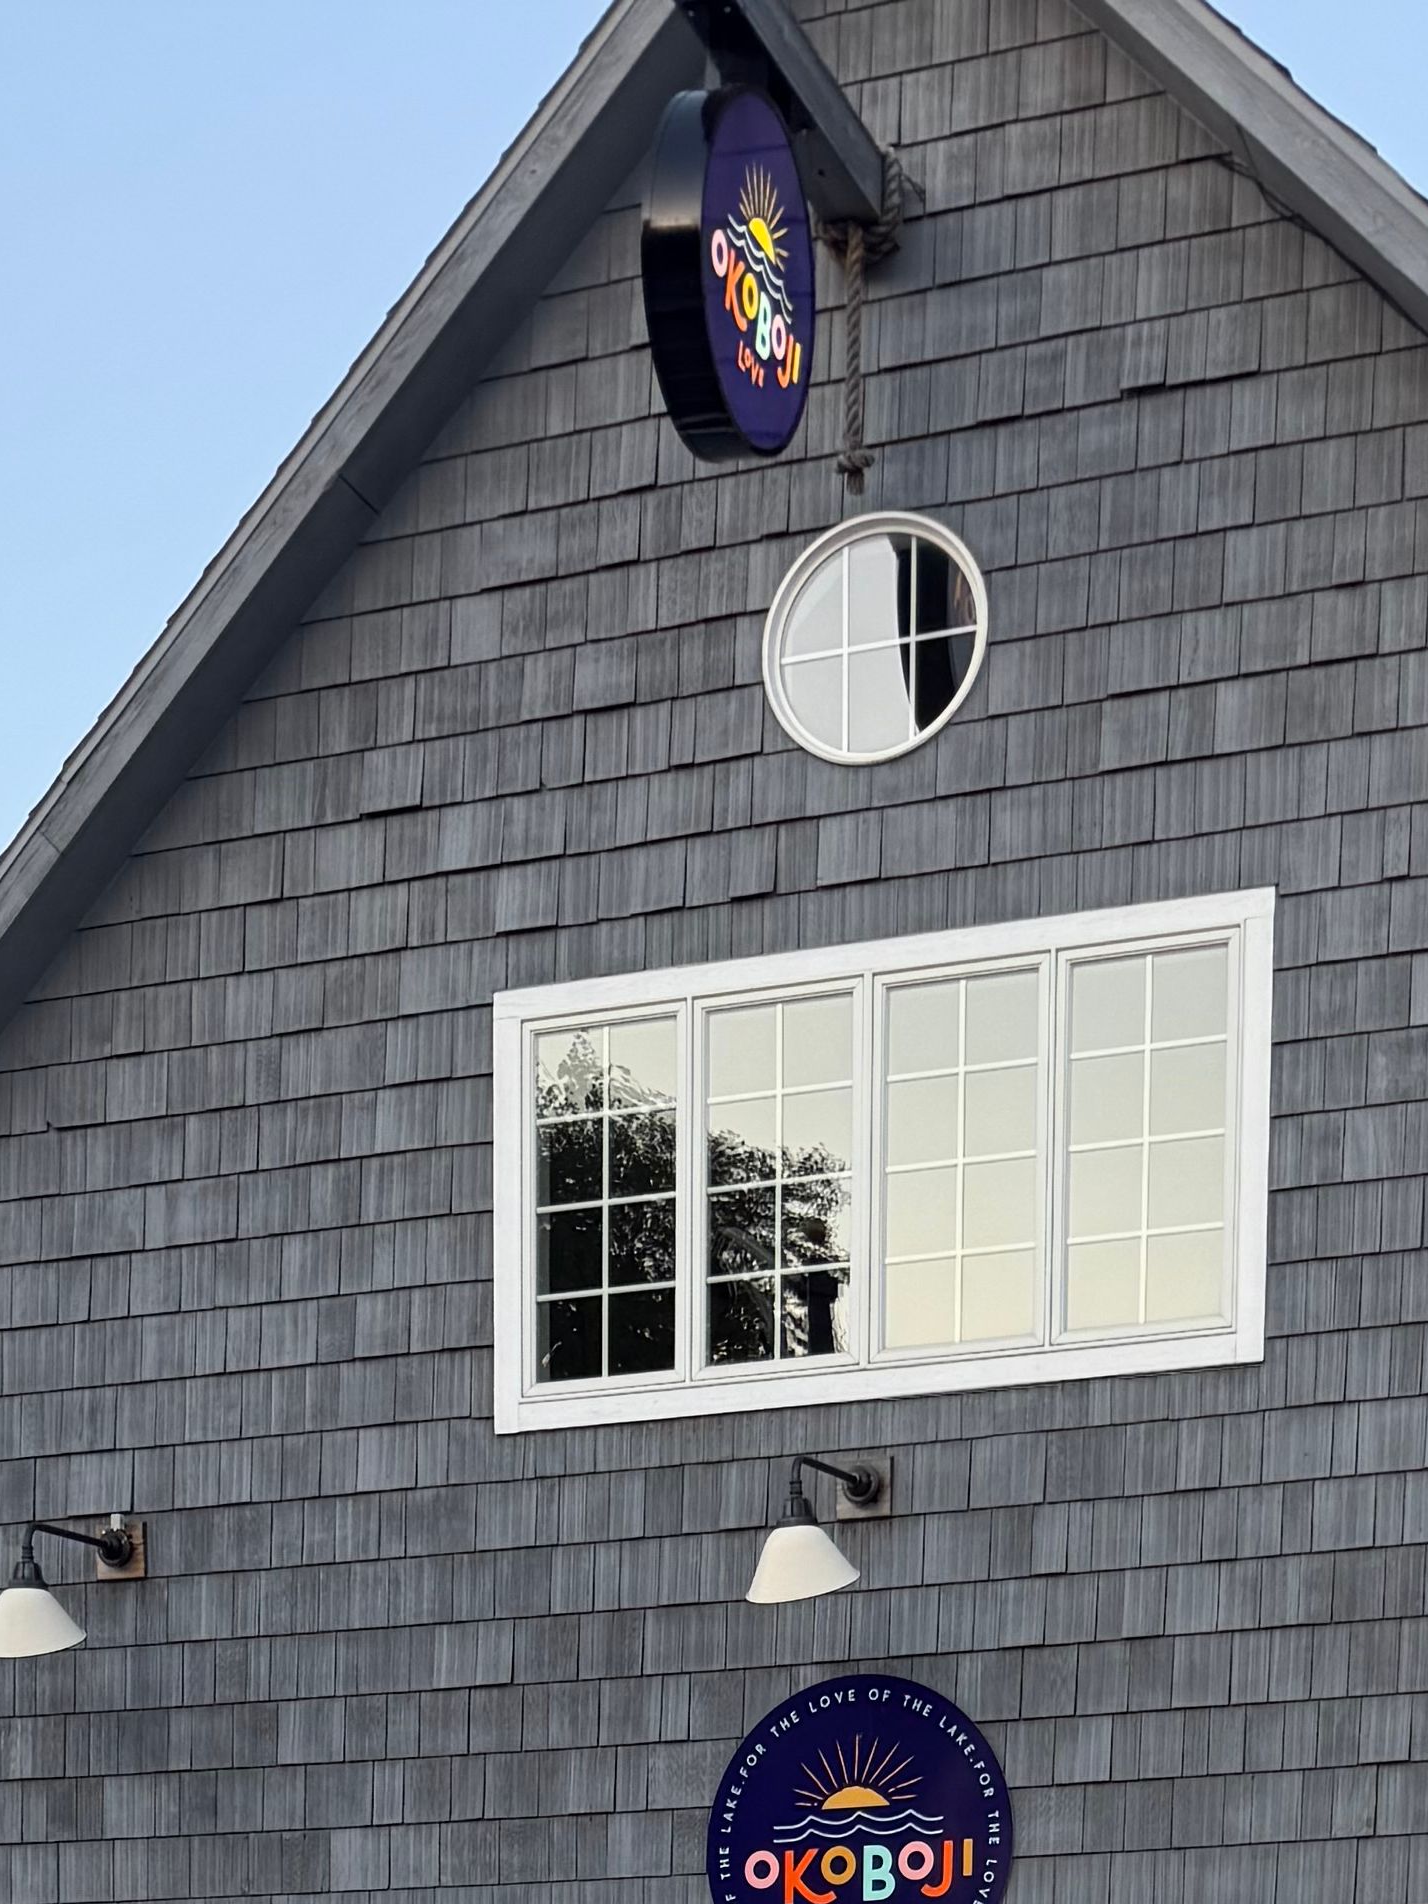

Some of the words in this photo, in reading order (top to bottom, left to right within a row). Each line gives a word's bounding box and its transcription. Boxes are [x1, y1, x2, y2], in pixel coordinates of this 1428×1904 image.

[711, 229, 802, 388] OKOBOJI
[737, 339, 765, 388] LOVE
[808, 1689, 856, 1713] LOVE
[868, 1688, 891, 1702] OF
[903, 1694, 933, 1717] THE
[770, 1710, 800, 1737] THE
[988, 1810, 1000, 1845] THE
[719, 1847, 731, 1880] THE
